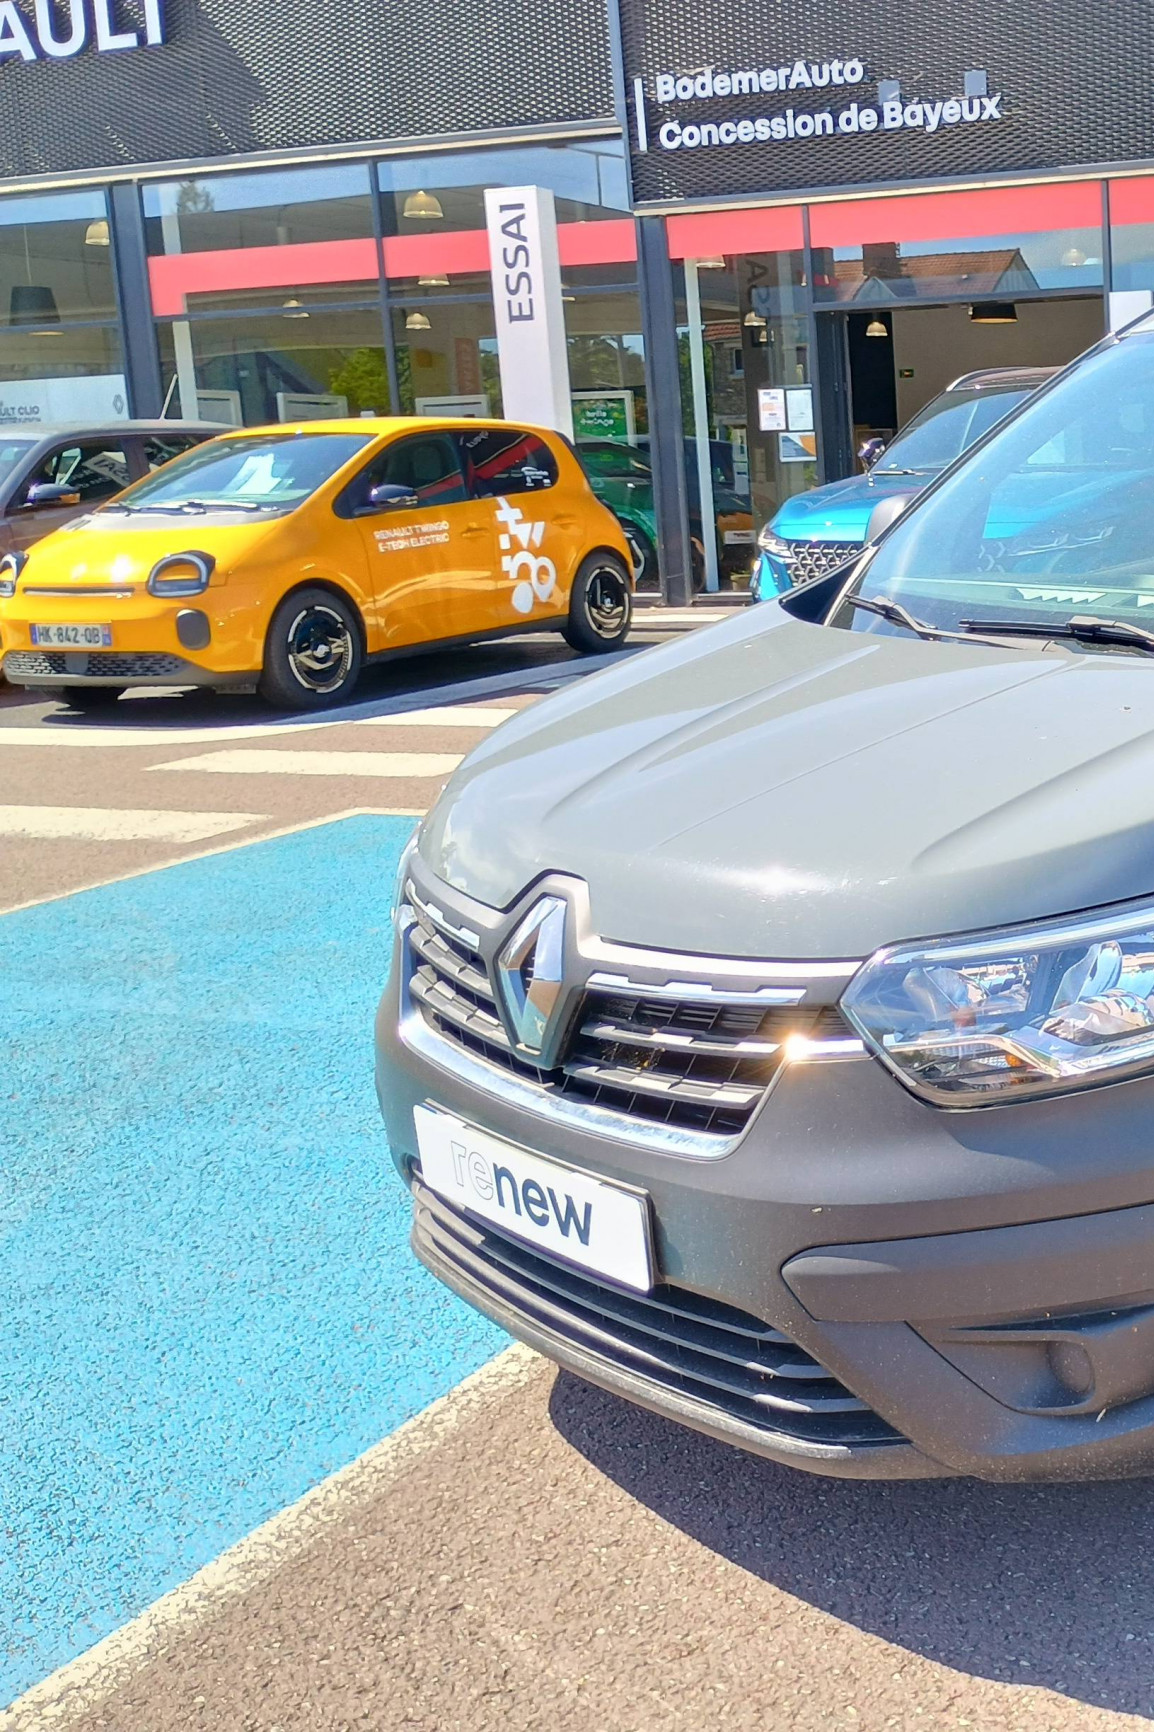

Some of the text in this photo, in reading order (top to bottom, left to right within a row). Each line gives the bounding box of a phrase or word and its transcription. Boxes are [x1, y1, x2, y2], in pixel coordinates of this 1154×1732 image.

[656, 58, 864, 101] BodemerAuto
[659, 92, 1002, 150] Concession de Bayeux
[499, 203, 535, 324] ESSAI
[18, 405, 40, 416] CLIO
[450, 1140, 593, 1247] renew
